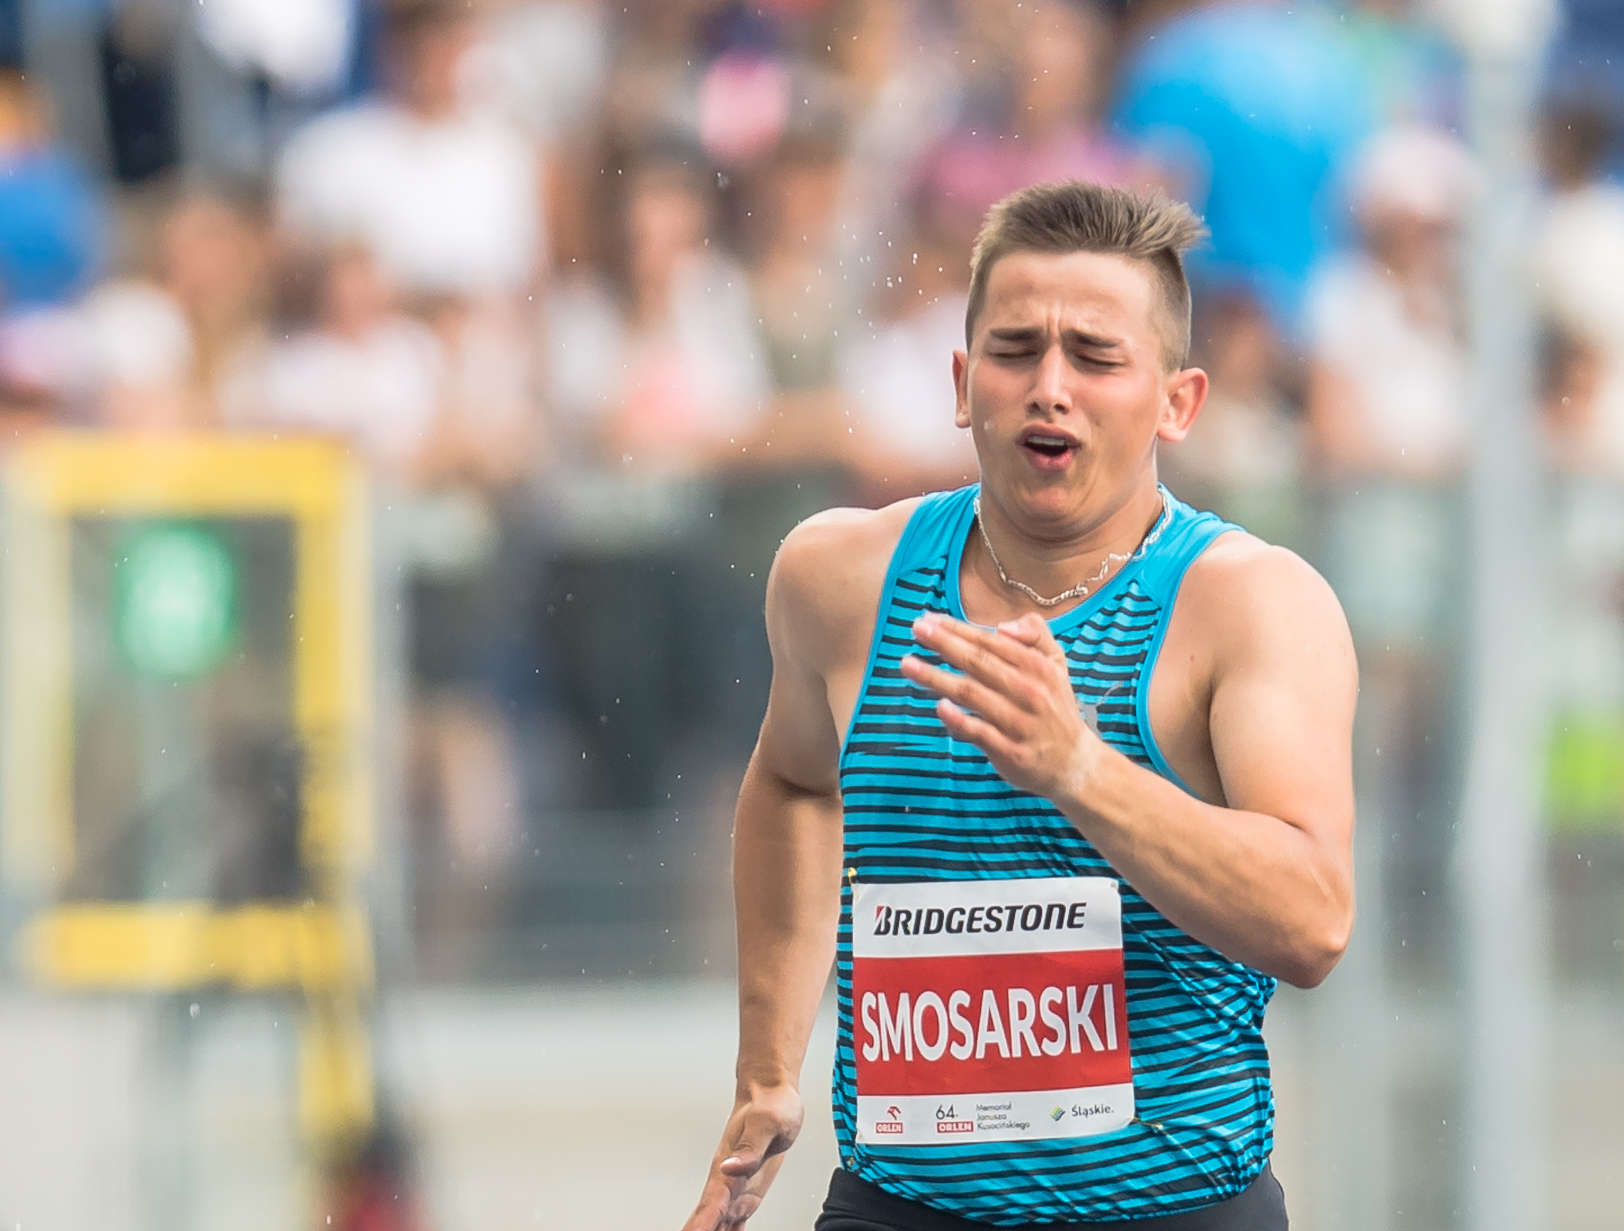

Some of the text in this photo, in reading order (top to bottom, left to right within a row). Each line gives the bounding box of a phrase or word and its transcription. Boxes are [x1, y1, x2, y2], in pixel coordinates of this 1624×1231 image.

[874, 902, 1087, 936] BRIDGESTONE
[861, 983, 1118, 1062] SMOSARSKI
[937, 1121, 974, 1133] ORLEN
